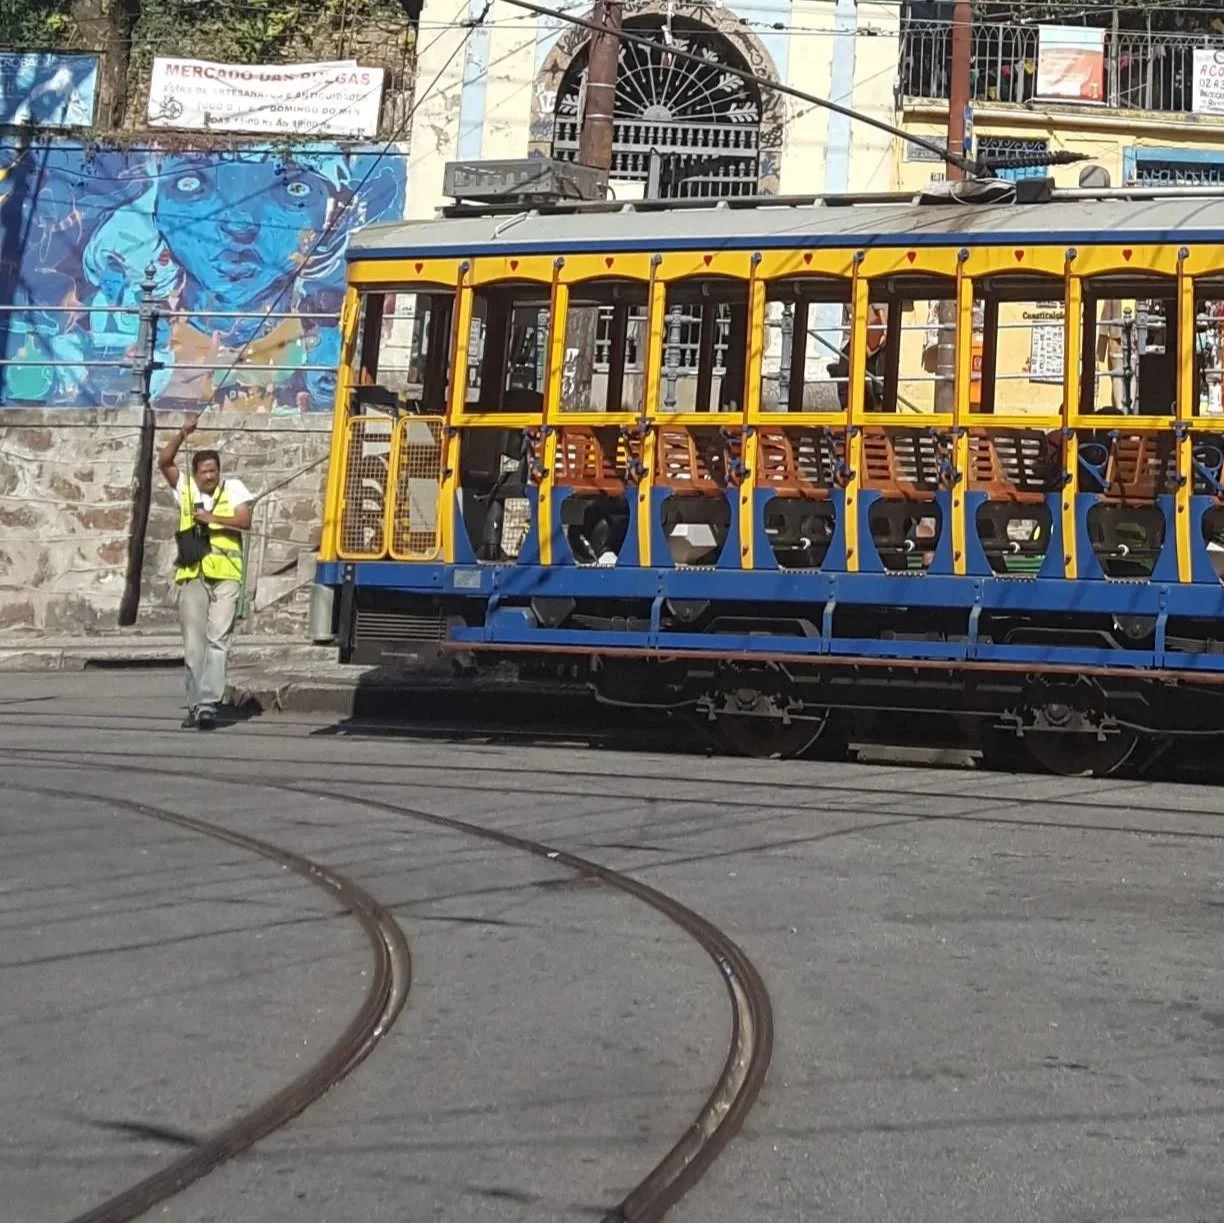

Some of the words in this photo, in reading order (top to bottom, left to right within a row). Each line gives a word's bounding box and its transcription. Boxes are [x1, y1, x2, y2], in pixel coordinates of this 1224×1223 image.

[166, 64, 253, 80] MERCADO
[301, 72, 370, 85] PGAS
[270, 104, 319, 114] DOMINGO
